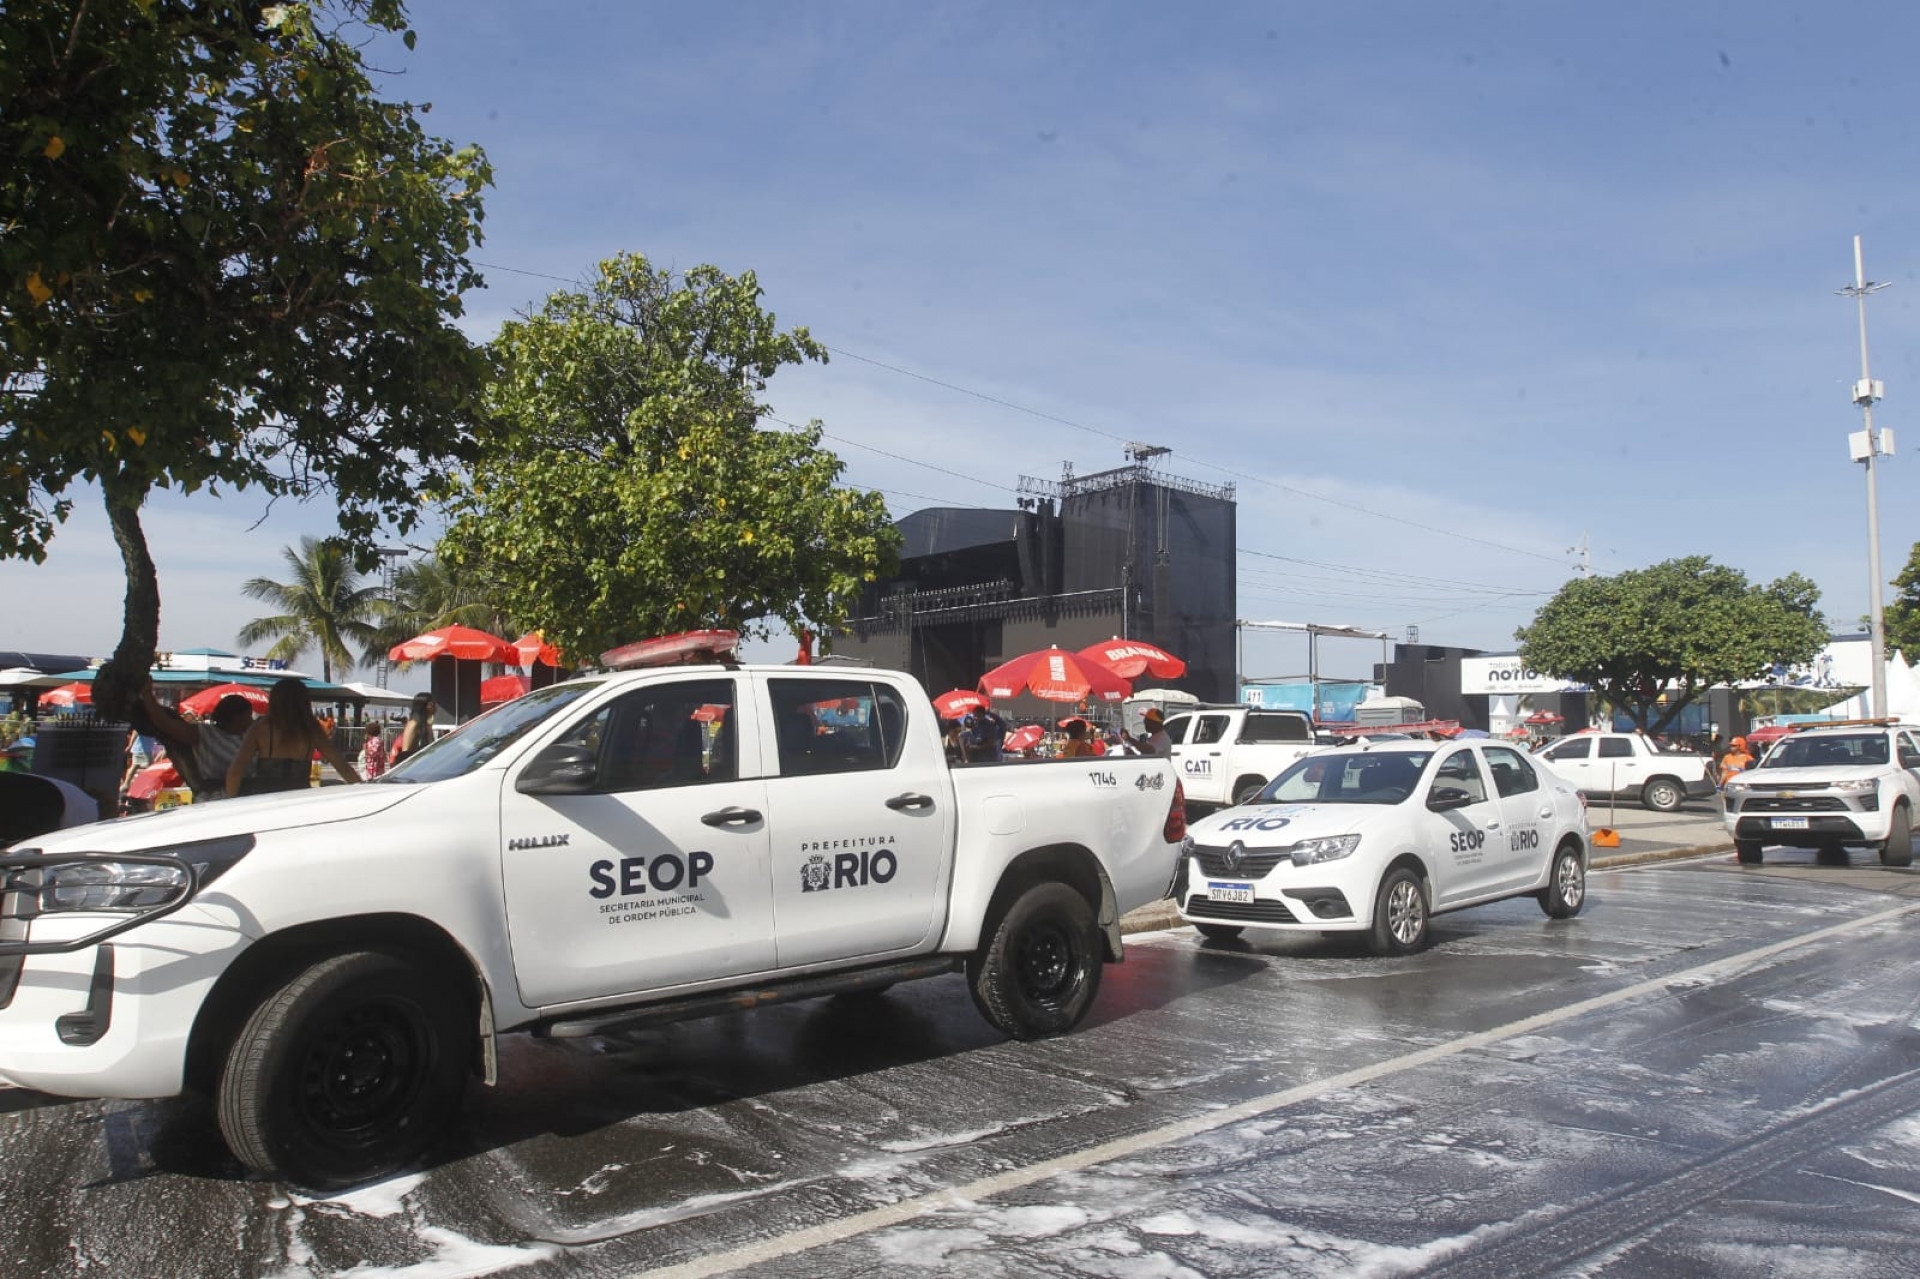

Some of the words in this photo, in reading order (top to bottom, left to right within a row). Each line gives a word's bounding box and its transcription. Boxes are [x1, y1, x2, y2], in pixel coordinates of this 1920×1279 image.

[1105, 646, 1169, 662] BRAHMA
[1185, 760, 1211, 773] CATI
[1089, 772, 1117, 786] 1746
[1219, 818, 1291, 831] RIO
[509, 834, 570, 850] HILUX
[802, 836, 895, 852] PREFEITURA
[1450, 830, 1485, 852] SEOP
[1520, 830, 1539, 850] RIO
[589, 851, 714, 899] SEOP
[834, 849, 897, 889] RIO
[599, 899, 655, 914] SECRETARIA
[657, 893, 705, 907] MUNICIPAL
[609, 915, 621, 925] DE
[623, 911, 657, 922] ORDEM
[659, 906, 697, 919] PÚBLICA
